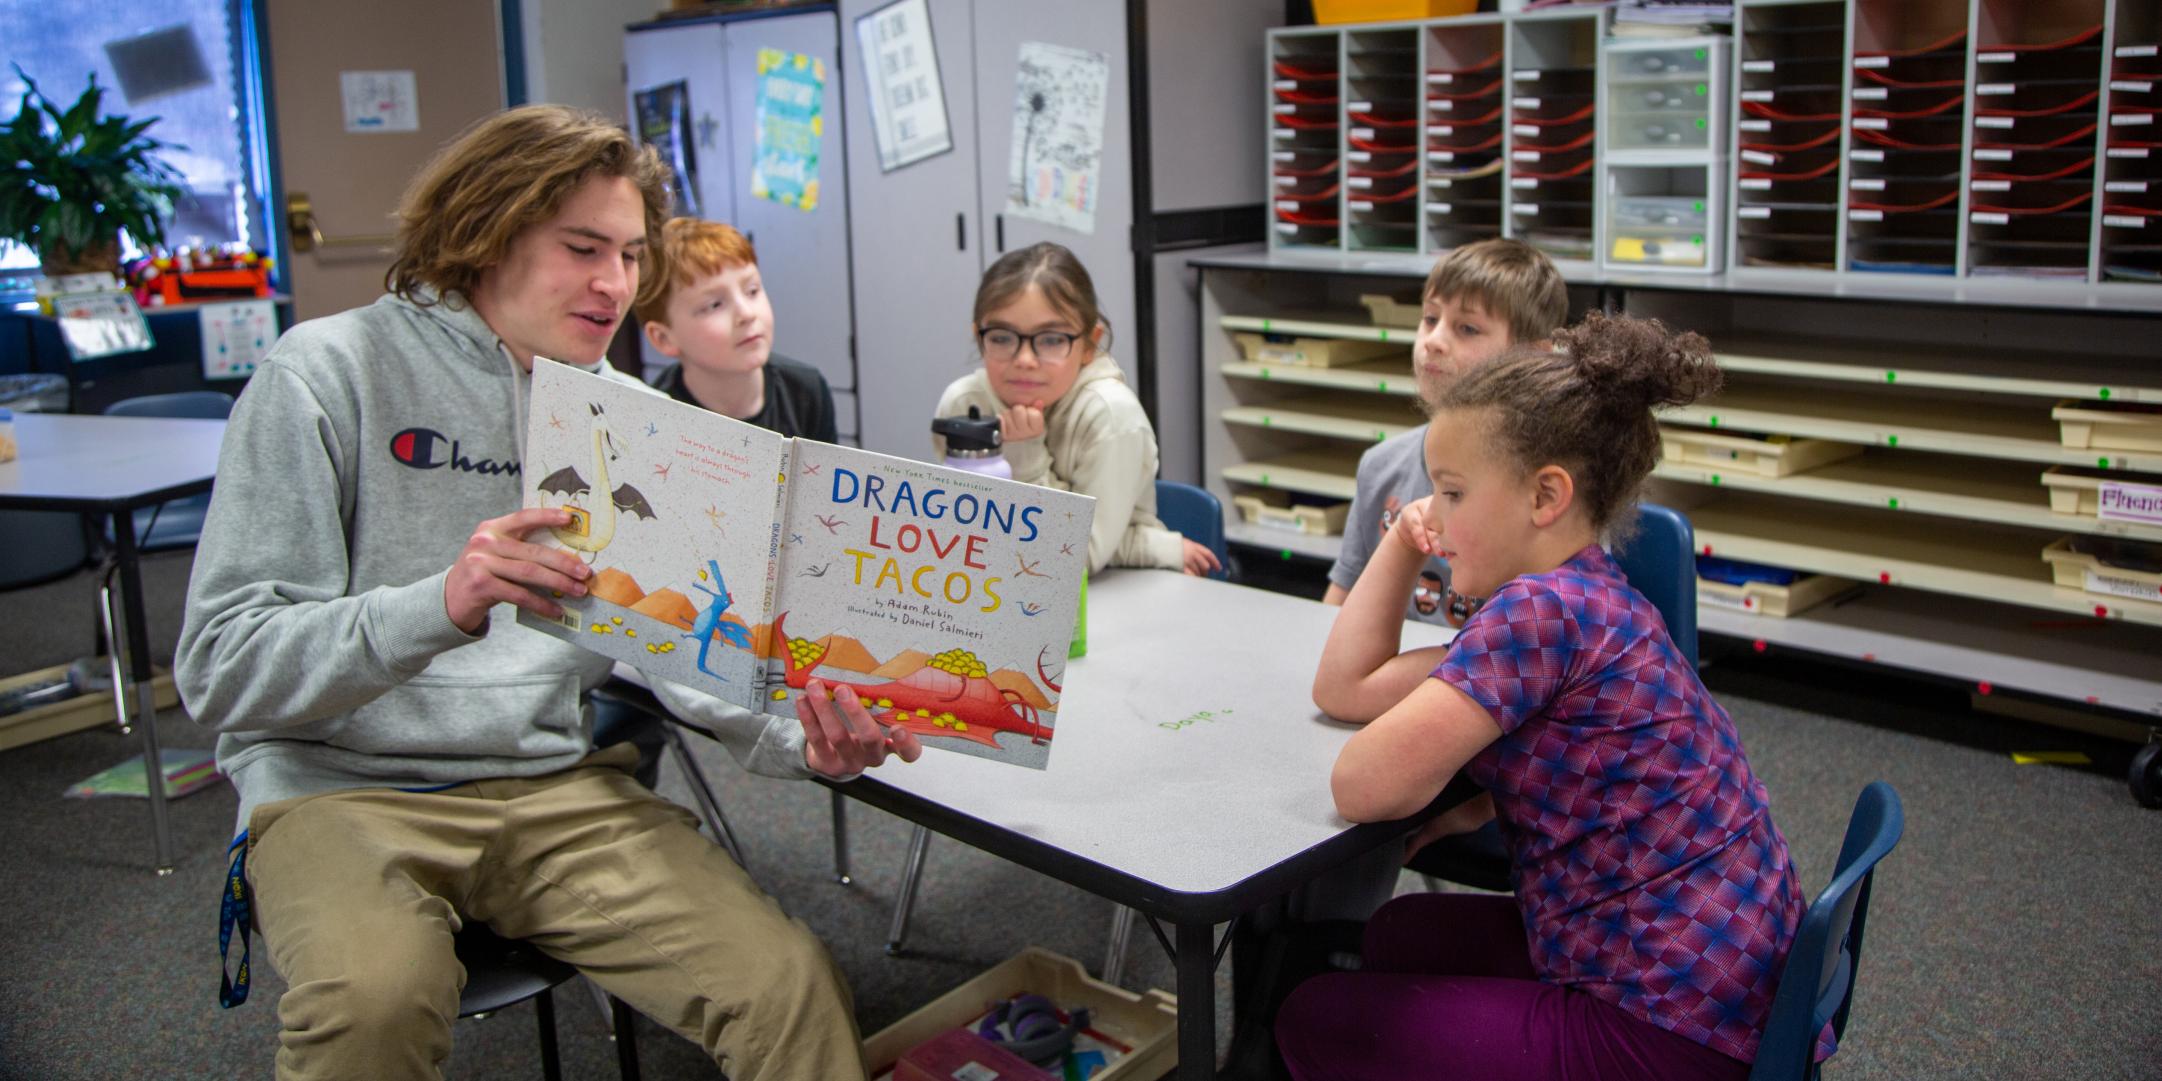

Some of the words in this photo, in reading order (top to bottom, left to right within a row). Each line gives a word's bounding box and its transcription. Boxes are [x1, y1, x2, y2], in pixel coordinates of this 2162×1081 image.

[884, 465, 901, 475] New
[905, 468, 924, 479] York
[927, 472, 950, 485] Times
[953, 479, 993, 493] bestseller
[831, 467, 1044, 542] DRAGONS
[769, 522, 780, 558] DRAGONS
[869, 515, 989, 570] LOVE
[766, 559, 776, 582] LOVE
[843, 547, 1003, 613] TACOS
[763, 585, 773, 612] TACOS
[875, 599, 884, 608] by
[887, 599, 918, 613] Adam
[922, 603, 954, 621] Rubin
[889, 612, 898, 623] by
[902, 613, 935, 630] Daniel
[939, 620, 985, 640] Salmieri
